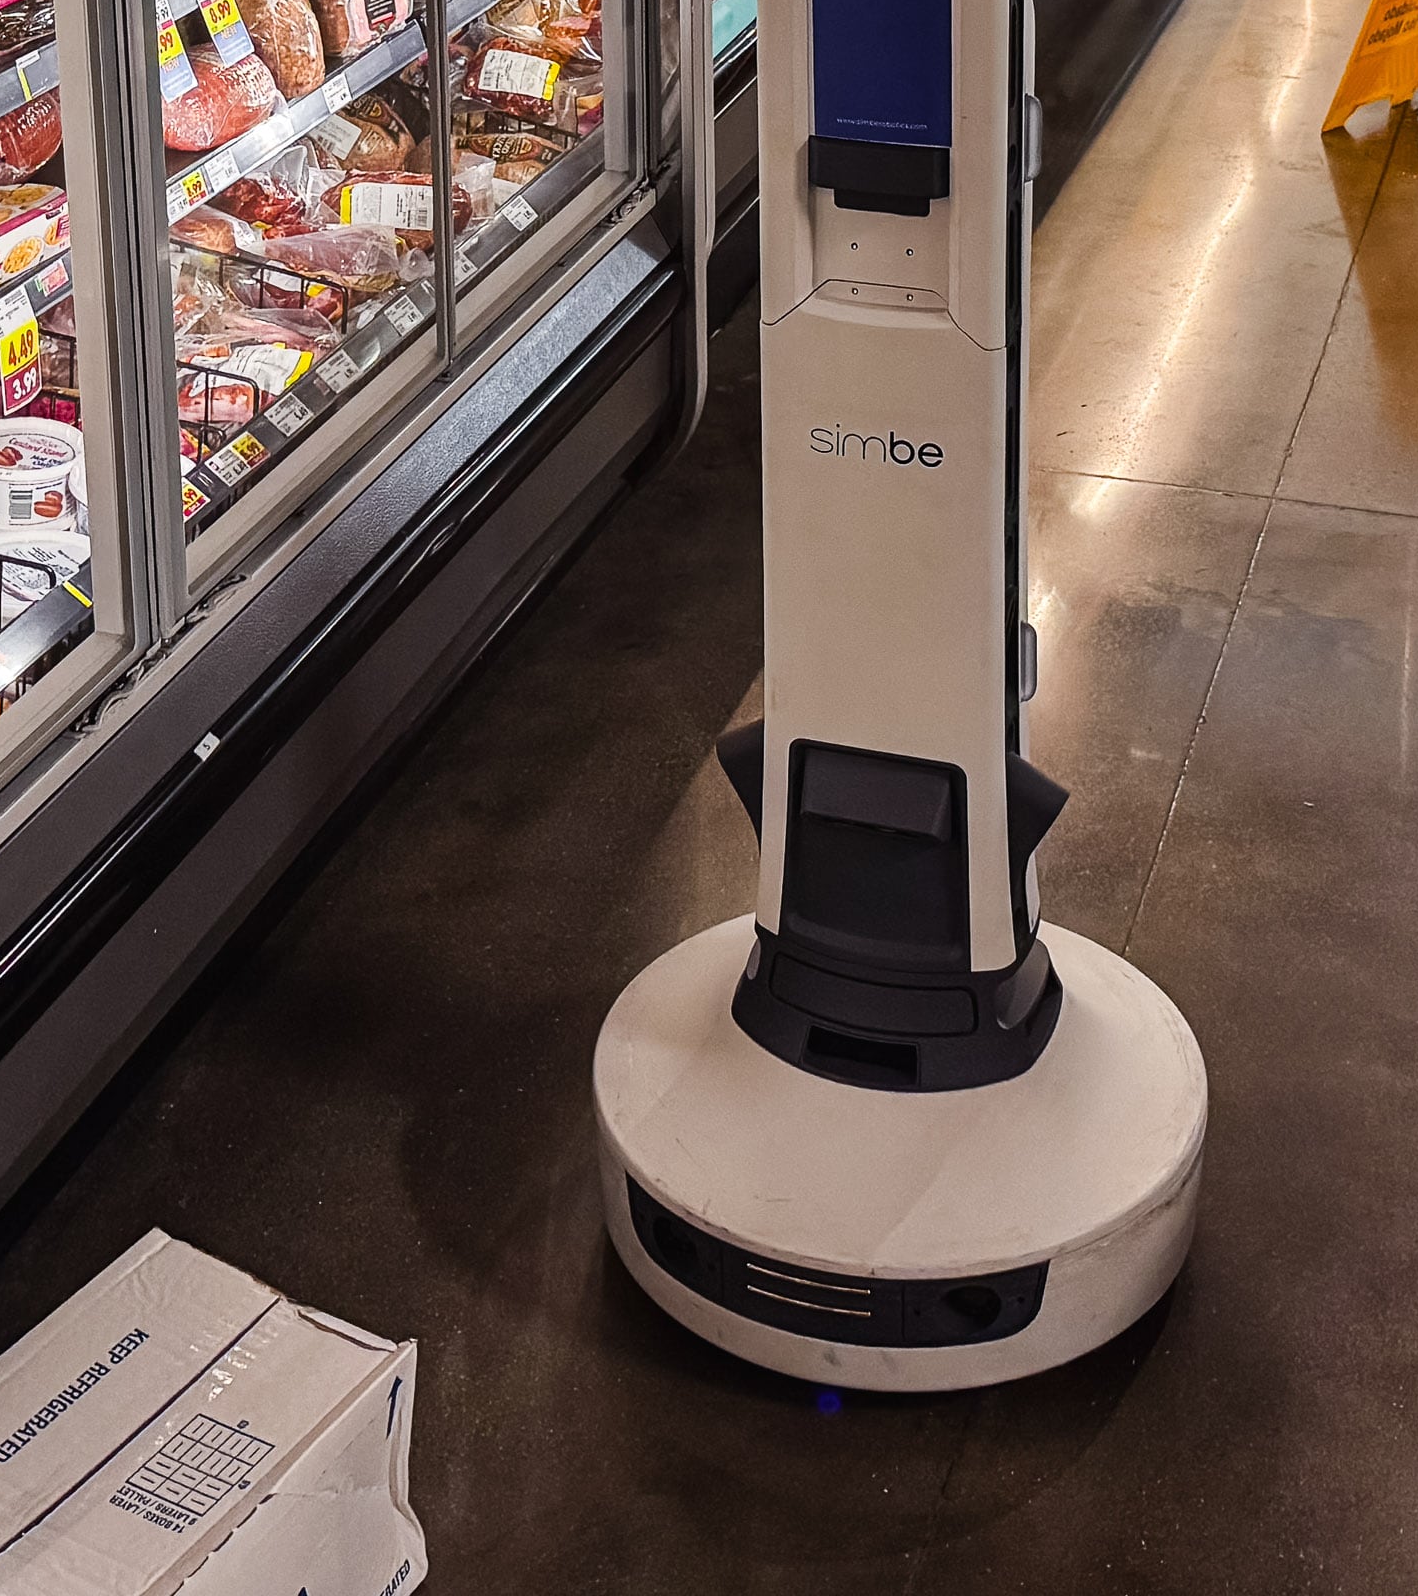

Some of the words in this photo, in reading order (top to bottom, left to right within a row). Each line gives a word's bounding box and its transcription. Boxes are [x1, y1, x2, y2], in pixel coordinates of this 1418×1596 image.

[108, 1328, 150, 1366] KEEP
[107, 1494, 139, 1518] LAYER
[115, 1485, 155, 1508] PALLET
[145, 1510, 173, 1531] BOXES
[160, 1502, 188, 1522] LAYERS
[172, 1521, 185, 1534] 14
